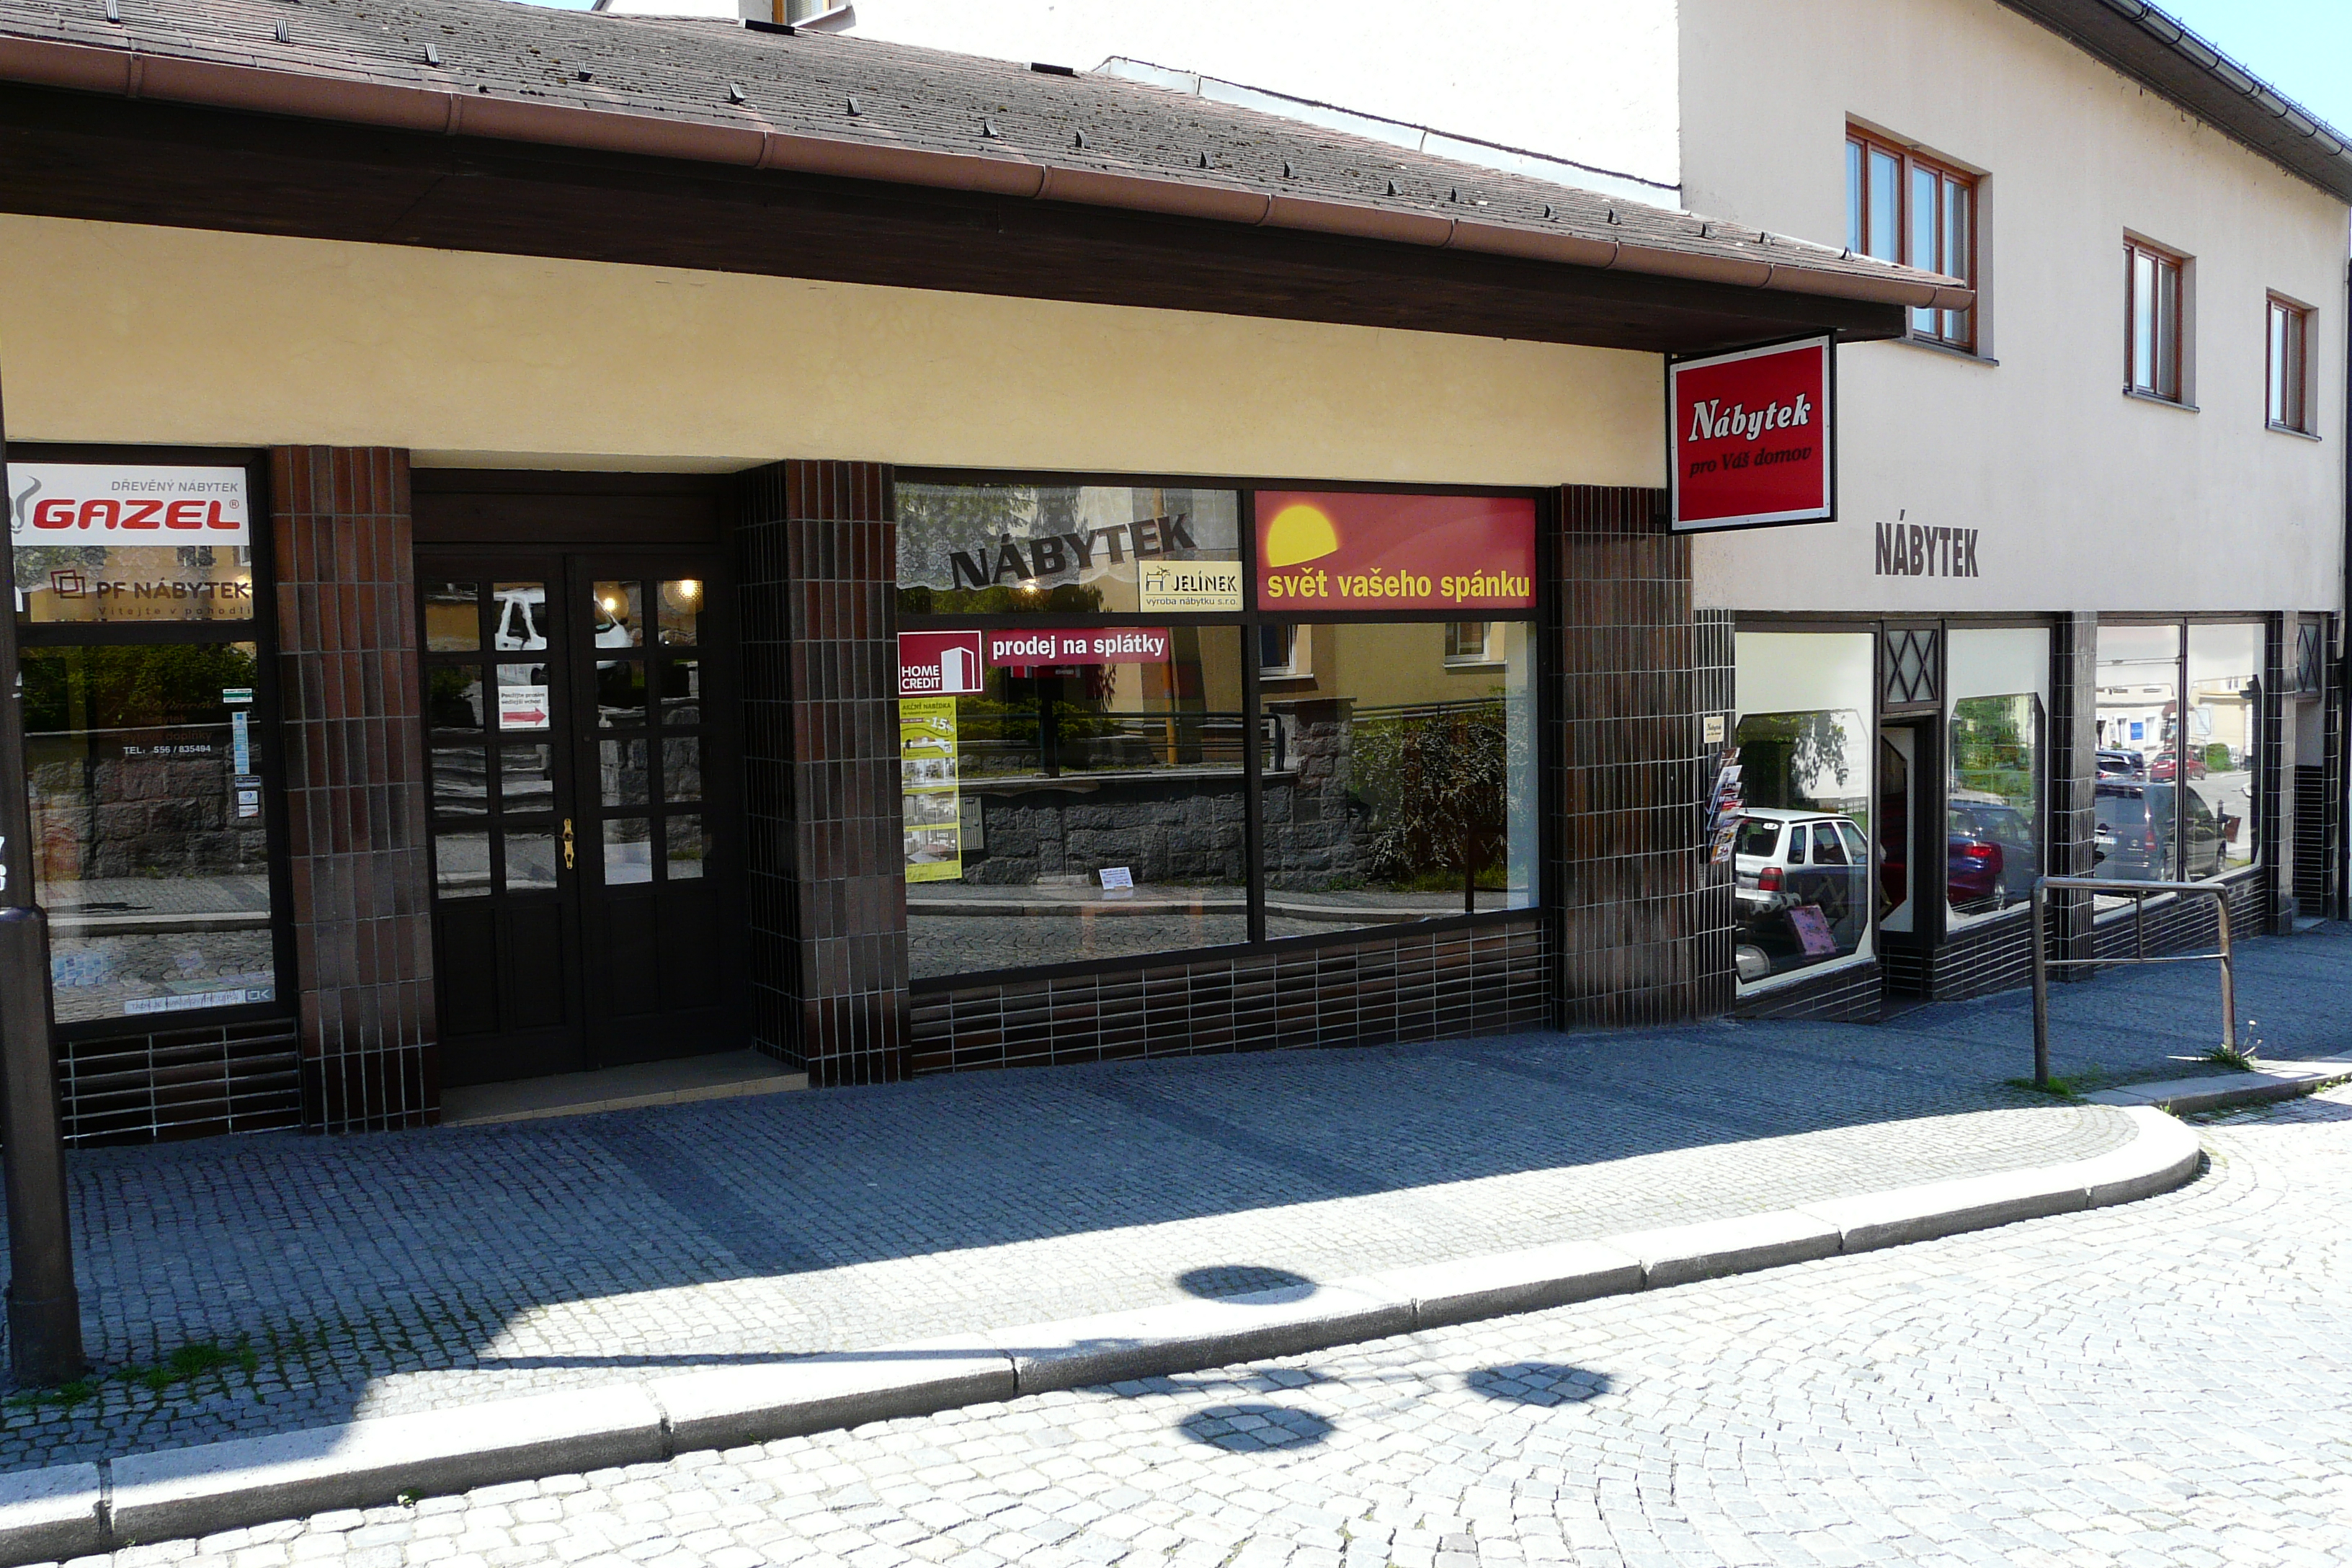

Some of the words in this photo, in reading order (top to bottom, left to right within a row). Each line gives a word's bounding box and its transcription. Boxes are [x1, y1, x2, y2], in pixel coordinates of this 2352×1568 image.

[1688, 393, 1812, 442] Nábytek
[1689, 459, 1716, 478] pro
[1722, 451, 1749, 471] Váš
[1753, 445, 1812, 467] domov
[111, 478, 175, 492] DŘEVĚNÝ
[178, 479, 239, 492] NÁBYTEK
[32, 499, 241, 530] GAZEL
[949, 512, 1197, 589] NÁBYTEK
[1875, 509, 1979, 578] NÁBYTEK
[97, 582, 126, 599] PF
[134, 577, 249, 599] NÁBYTEK
[1172, 570, 1237, 592] JELÍNEK
[1267, 567, 1327, 597] svět
[1337, 568, 1432, 597] vašeho
[1440, 569, 1530, 602] spánku
[1146, 597, 1177, 607] výroba
[1180, 597, 1215, 607] nábytku
[993, 636, 1055, 660] prodej
[1063, 638, 1087, 654] na
[1093, 633, 1164, 657] splátky
[901, 665, 939, 677] HOME
[901, 676, 940, 689] CREDIT
[179, 744, 211, 753] 835494
